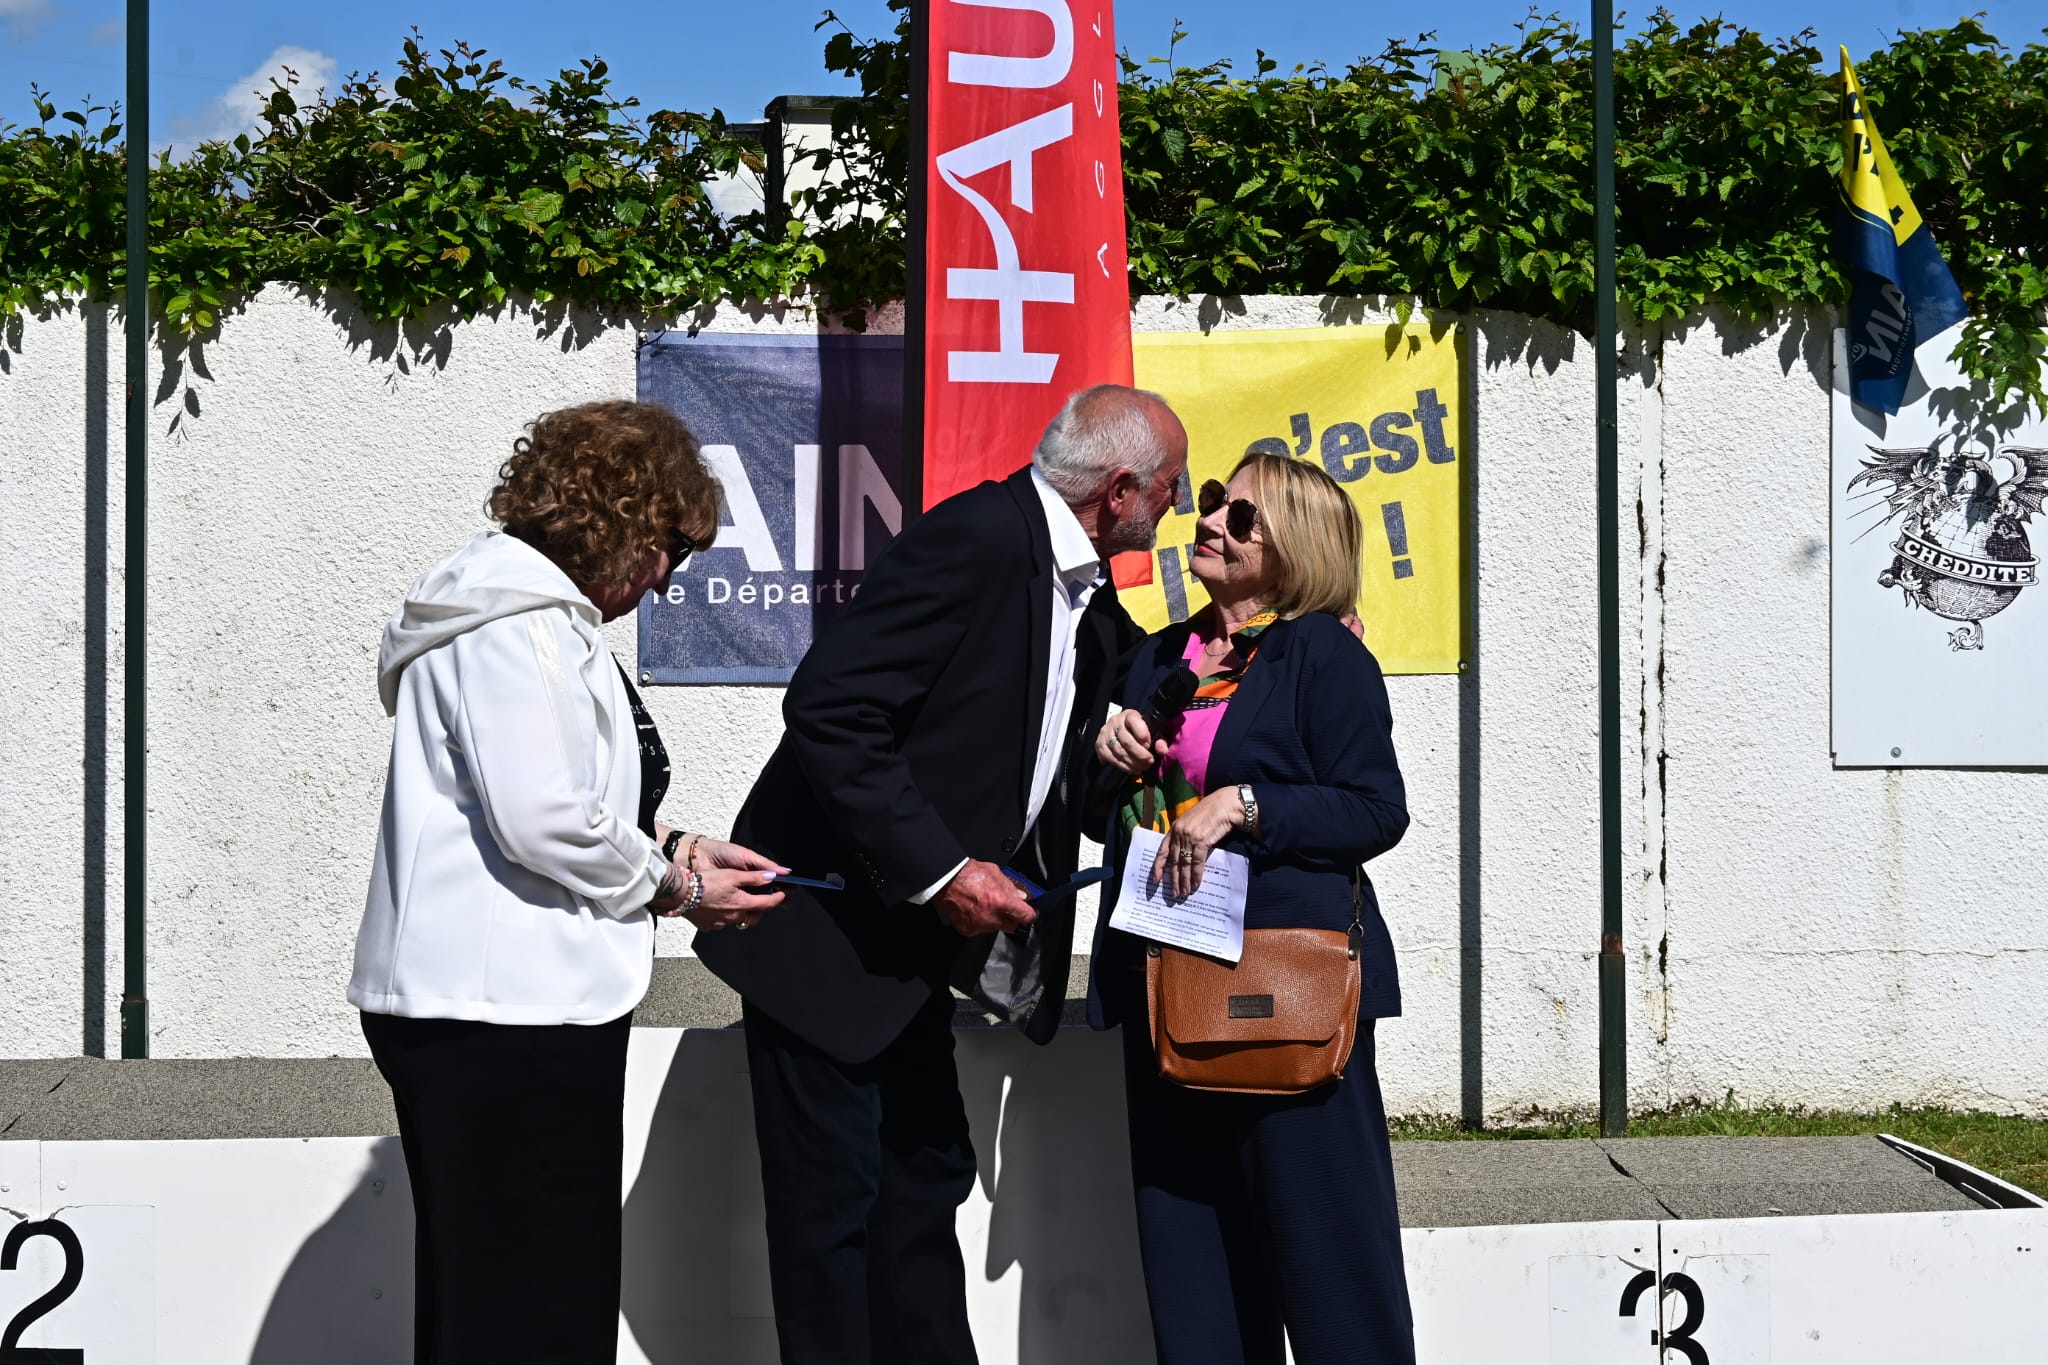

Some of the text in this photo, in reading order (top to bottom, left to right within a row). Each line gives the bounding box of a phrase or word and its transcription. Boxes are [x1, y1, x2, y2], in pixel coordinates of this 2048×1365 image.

[707, 577, 860, 609] Départ
[1904, 540, 2031, 582] CHEDDITE
[0, 1218, 84, 1365] 2
[1619, 1270, 1710, 1365] 3
